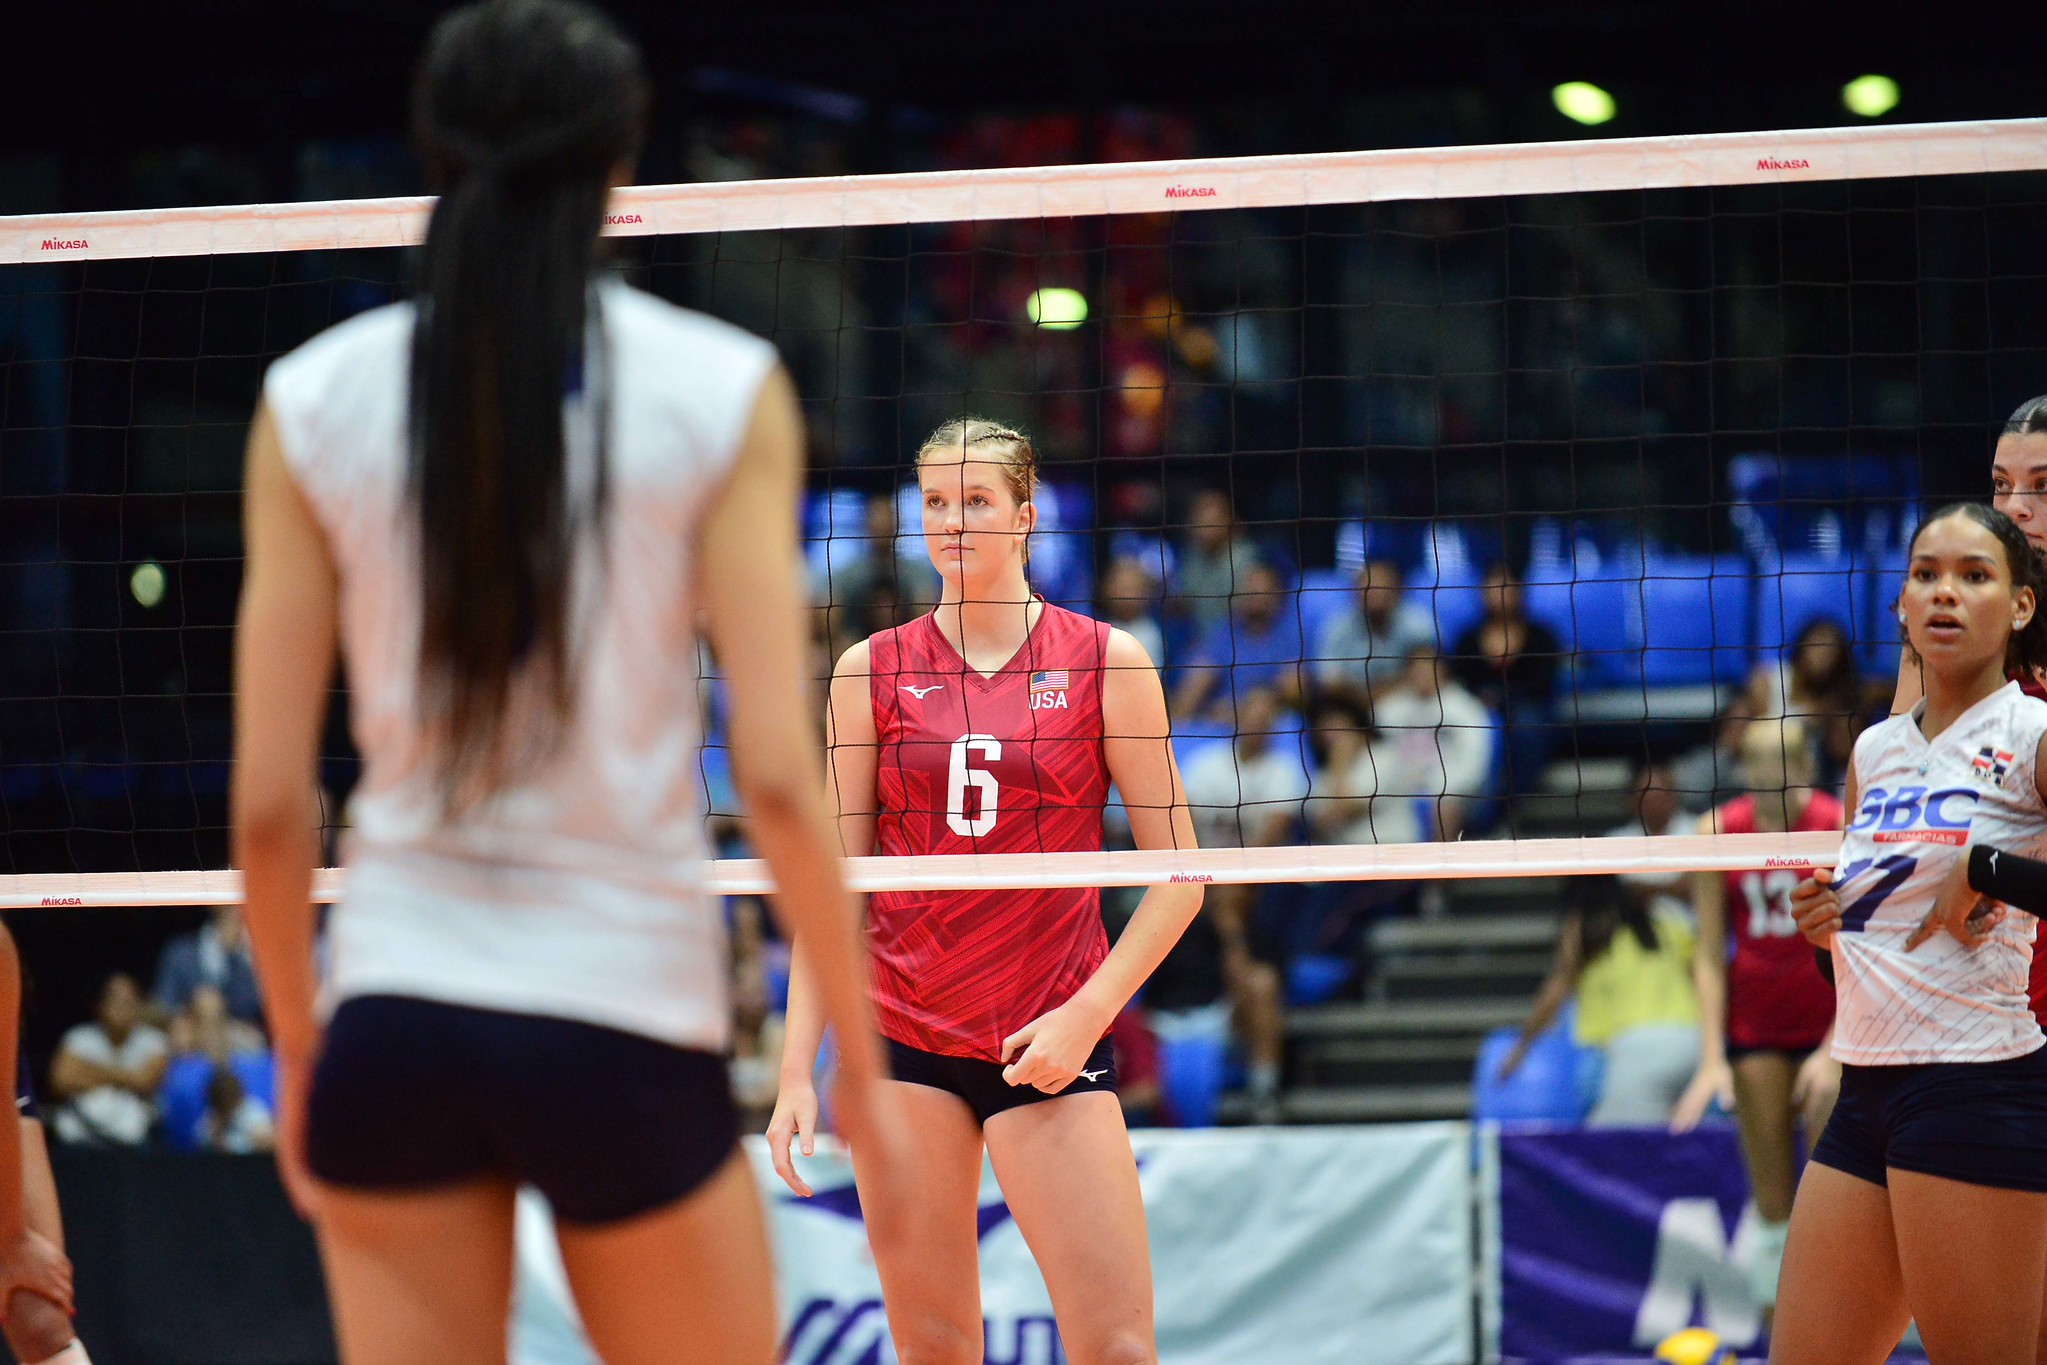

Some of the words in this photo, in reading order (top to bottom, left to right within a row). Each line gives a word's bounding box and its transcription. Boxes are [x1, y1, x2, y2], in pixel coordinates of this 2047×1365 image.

[1028, 690, 1069, 710] USA
[946, 733, 1002, 838] 6
[1846, 786, 1980, 832] GBC
[1883, 831, 1958, 845] FARMACIAS
[1741, 869, 1798, 939] 13
